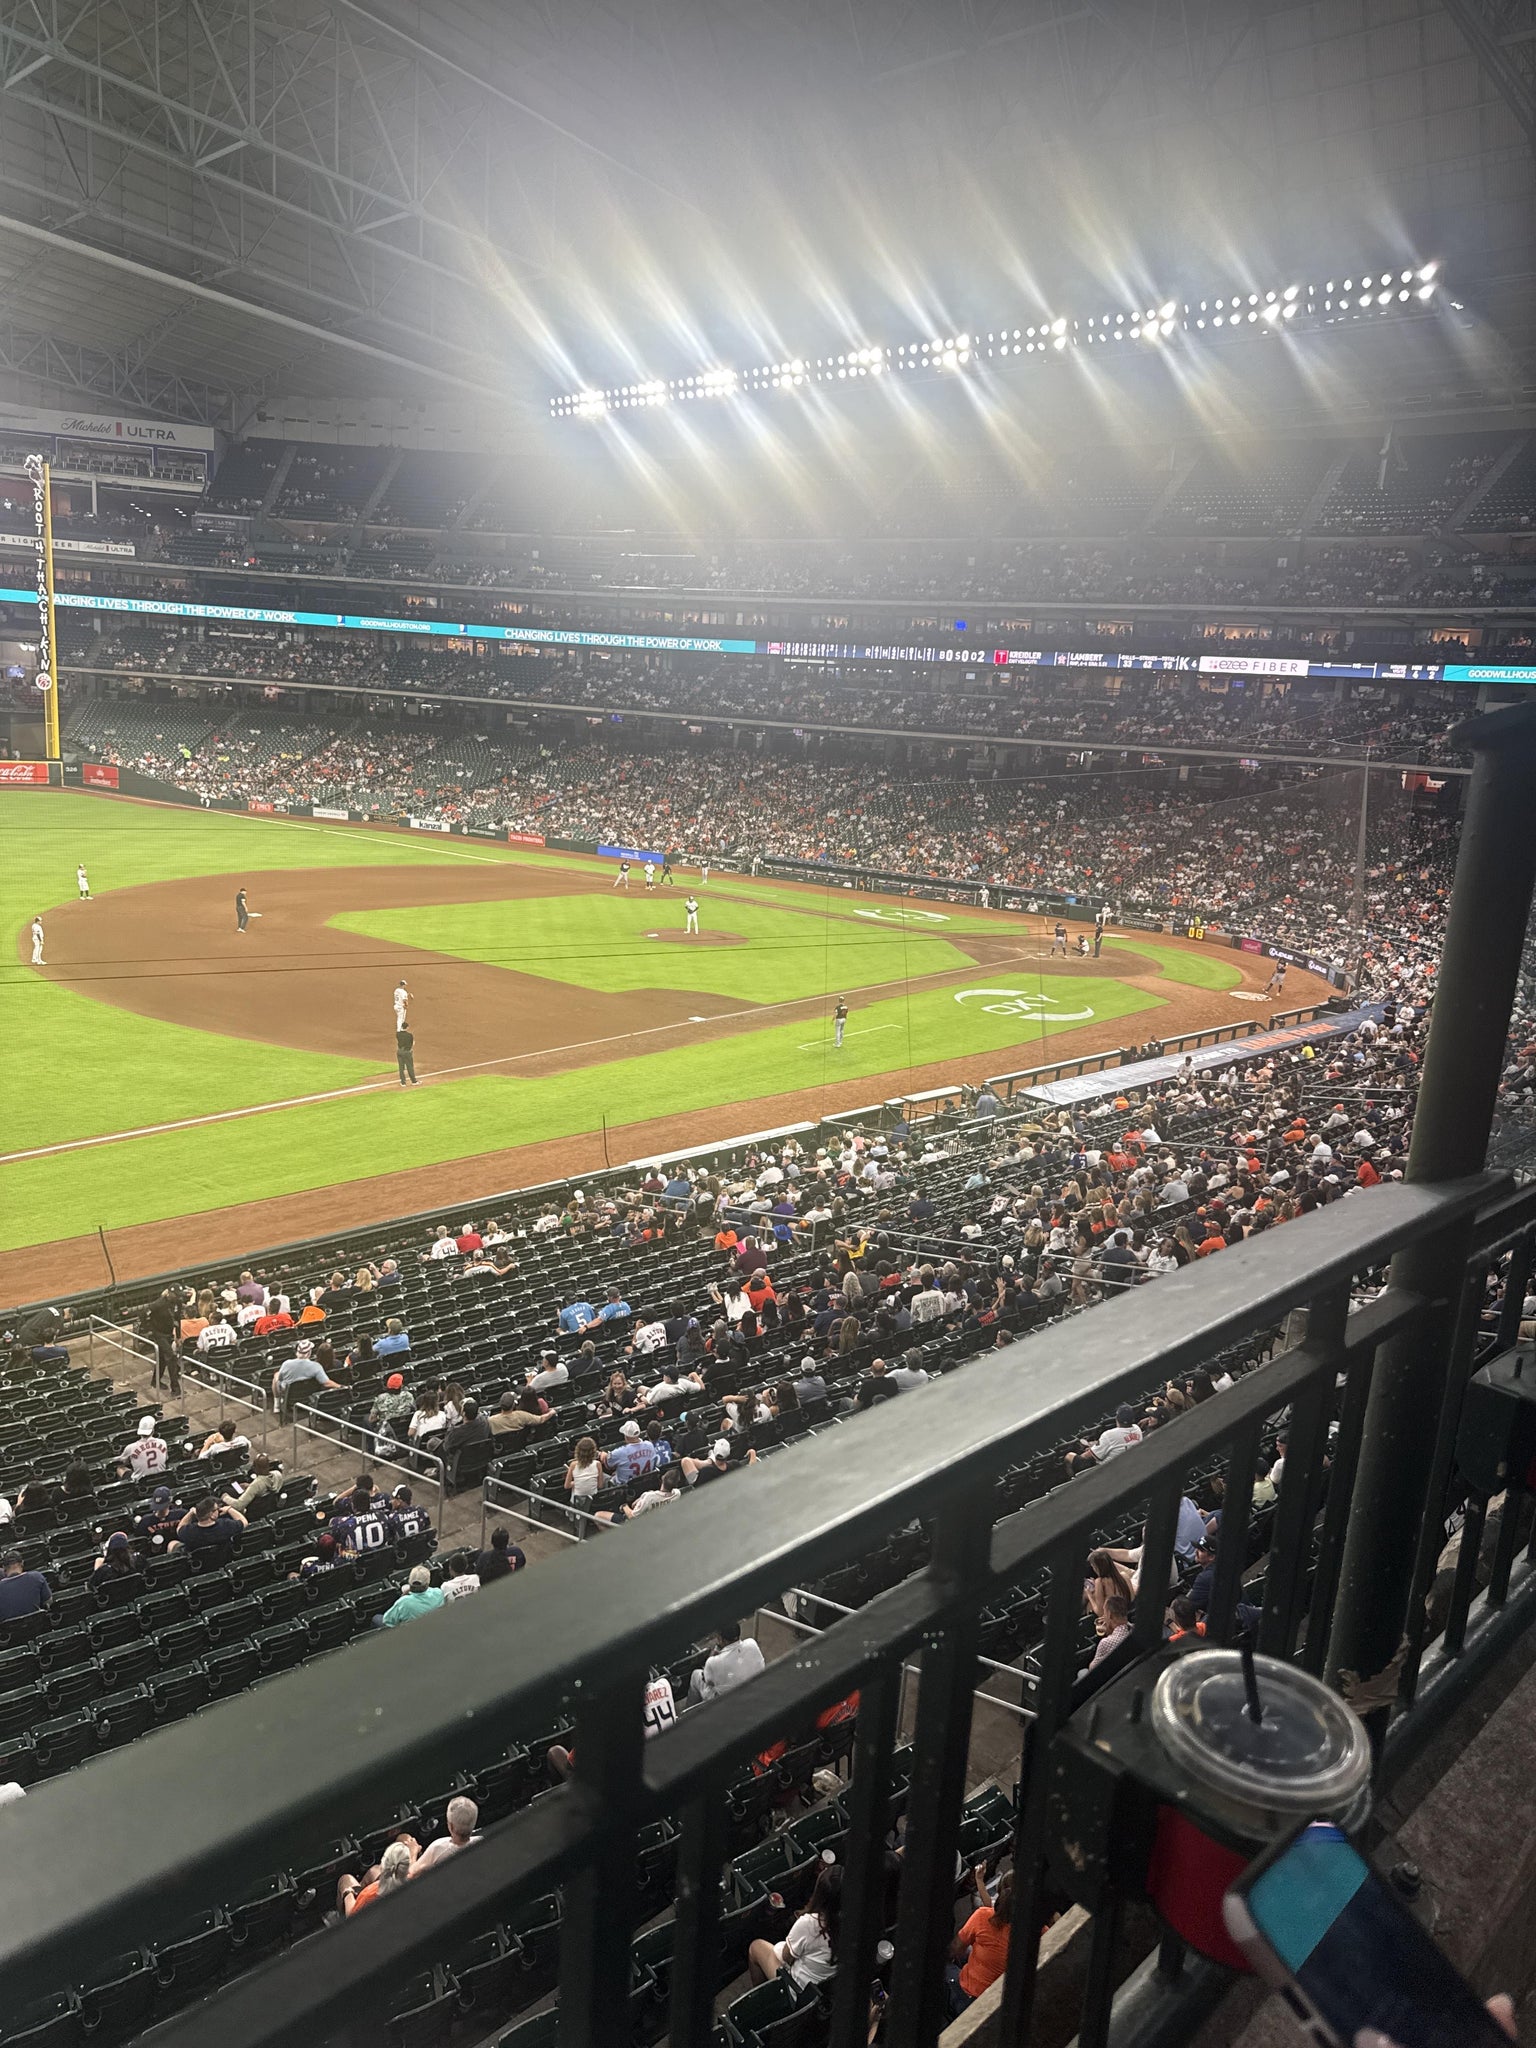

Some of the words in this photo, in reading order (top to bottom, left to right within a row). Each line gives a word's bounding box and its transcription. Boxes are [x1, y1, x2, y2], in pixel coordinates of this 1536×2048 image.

[61, 417, 113, 434] Michelob
[127, 425, 176, 441] ULTRA
[33, 487, 43, 536] ROOT
[34, 539, 44, 554] 4
[110, 545, 133, 553] ULTRA
[36, 558, 47, 594] THA
[54, 595, 96, 607] ANGING
[97, 598, 129, 609] LIVES
[130, 600, 183, 613] THROUGH
[186, 605, 206, 616] THE
[207, 607, 247, 619] POWER
[248, 610, 262, 620] OF
[38, 600, 50, 671] CHIKIN
[504, 629, 554, 641] CHANGING
[554, 632, 580, 643] LIVES
[581, 634, 626, 647] THROUGH
[627, 637, 645, 647] THE
[646, 638, 679, 649] POWER
[679, 639, 692, 650] OF
[977, 650, 985, 662] 2
[1009, 651, 1042, 659] KREIDLER
[1070, 653, 1104, 661] LAMBERT
[1179, 657, 1190, 670] K
[1218, 660, 1248, 671] ezee
[1253, 661, 1298, 673] FIBER
[981, 994, 1059, 1015] OXY
[575, 1312, 588, 1328] 5
[131, 1442, 167, 1459] BREGMAN
[146, 1450, 157, 1468] 2
[354, 1522, 384, 1551] 10
[644, 1701, 676, 1732] 44
